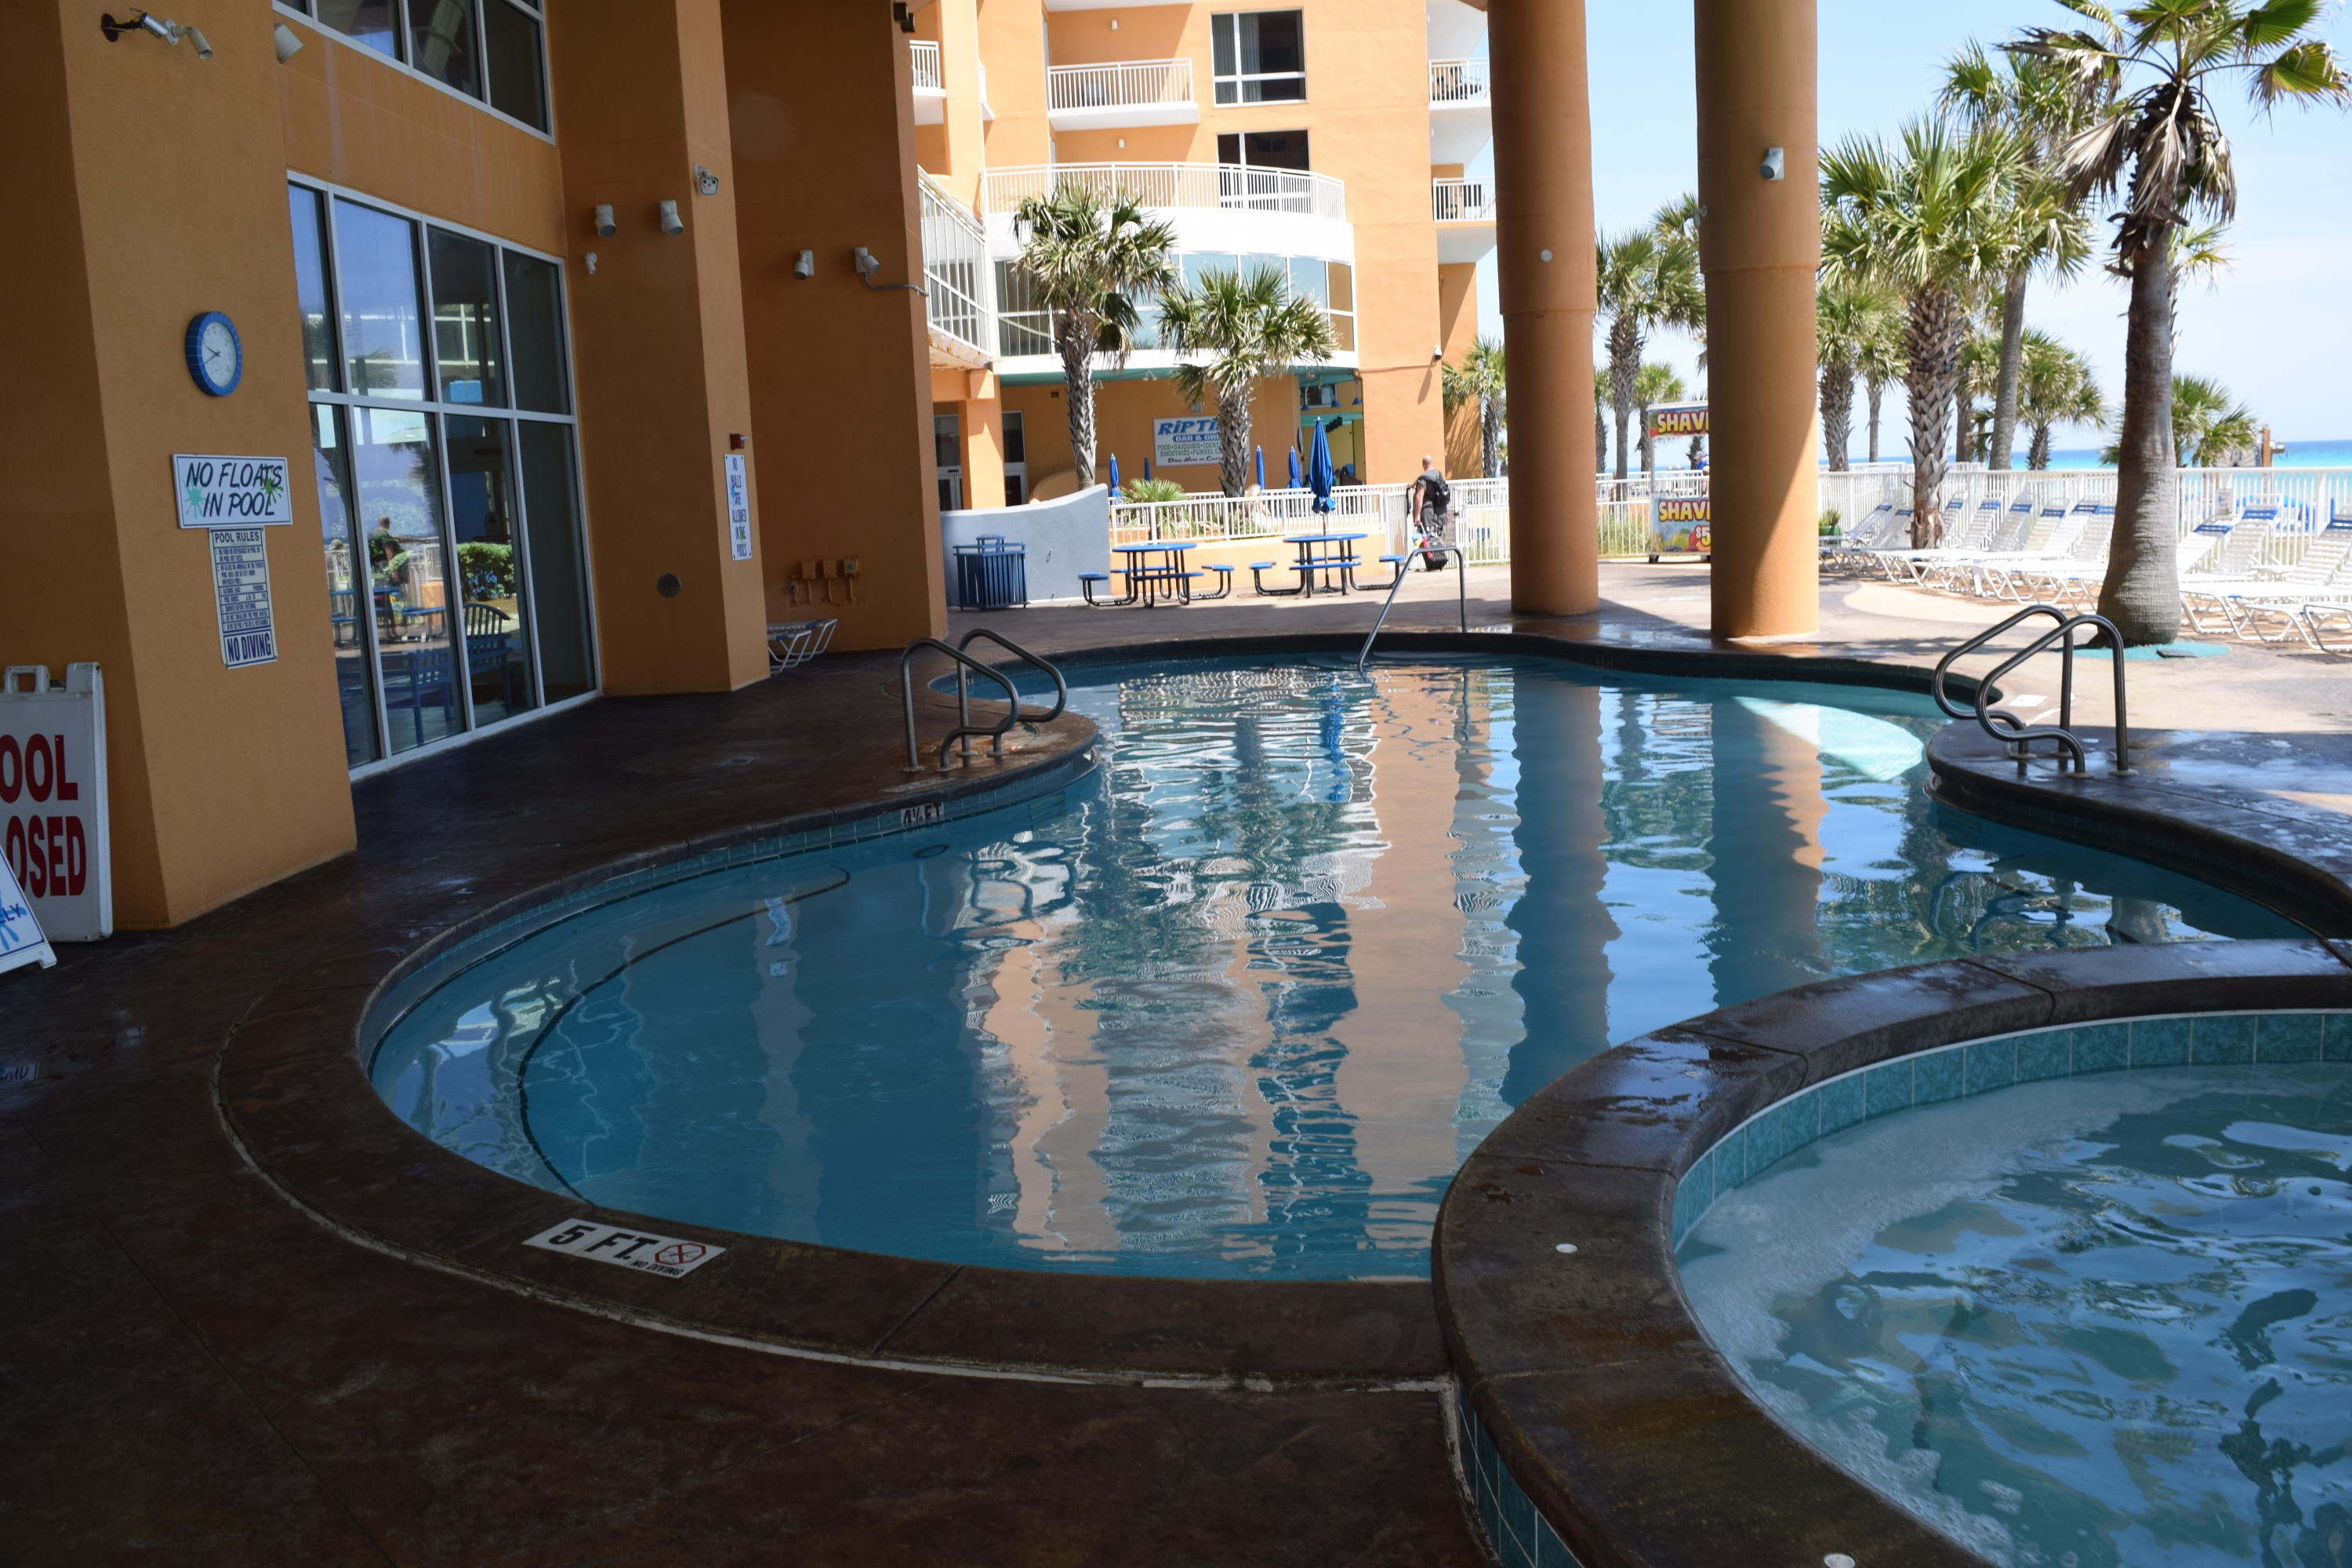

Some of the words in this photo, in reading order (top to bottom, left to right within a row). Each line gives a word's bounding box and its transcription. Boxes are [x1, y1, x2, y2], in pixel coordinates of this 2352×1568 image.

[732, 457, 738, 470] NO
[186, 462, 213, 488] NO
[219, 463, 283, 488] FLOATS
[731, 474, 742, 488] BALLS
[203, 492, 223, 517] IN
[228, 492, 274, 517] POOL
[215, 532, 234, 543] POOL
[236, 532, 260, 542] RULES
[227, 637, 240, 662] NO
[241, 633, 271, 660] DIVING
[549, 1225, 597, 1245] 5
[647, 1264, 684, 1276] DIVING
